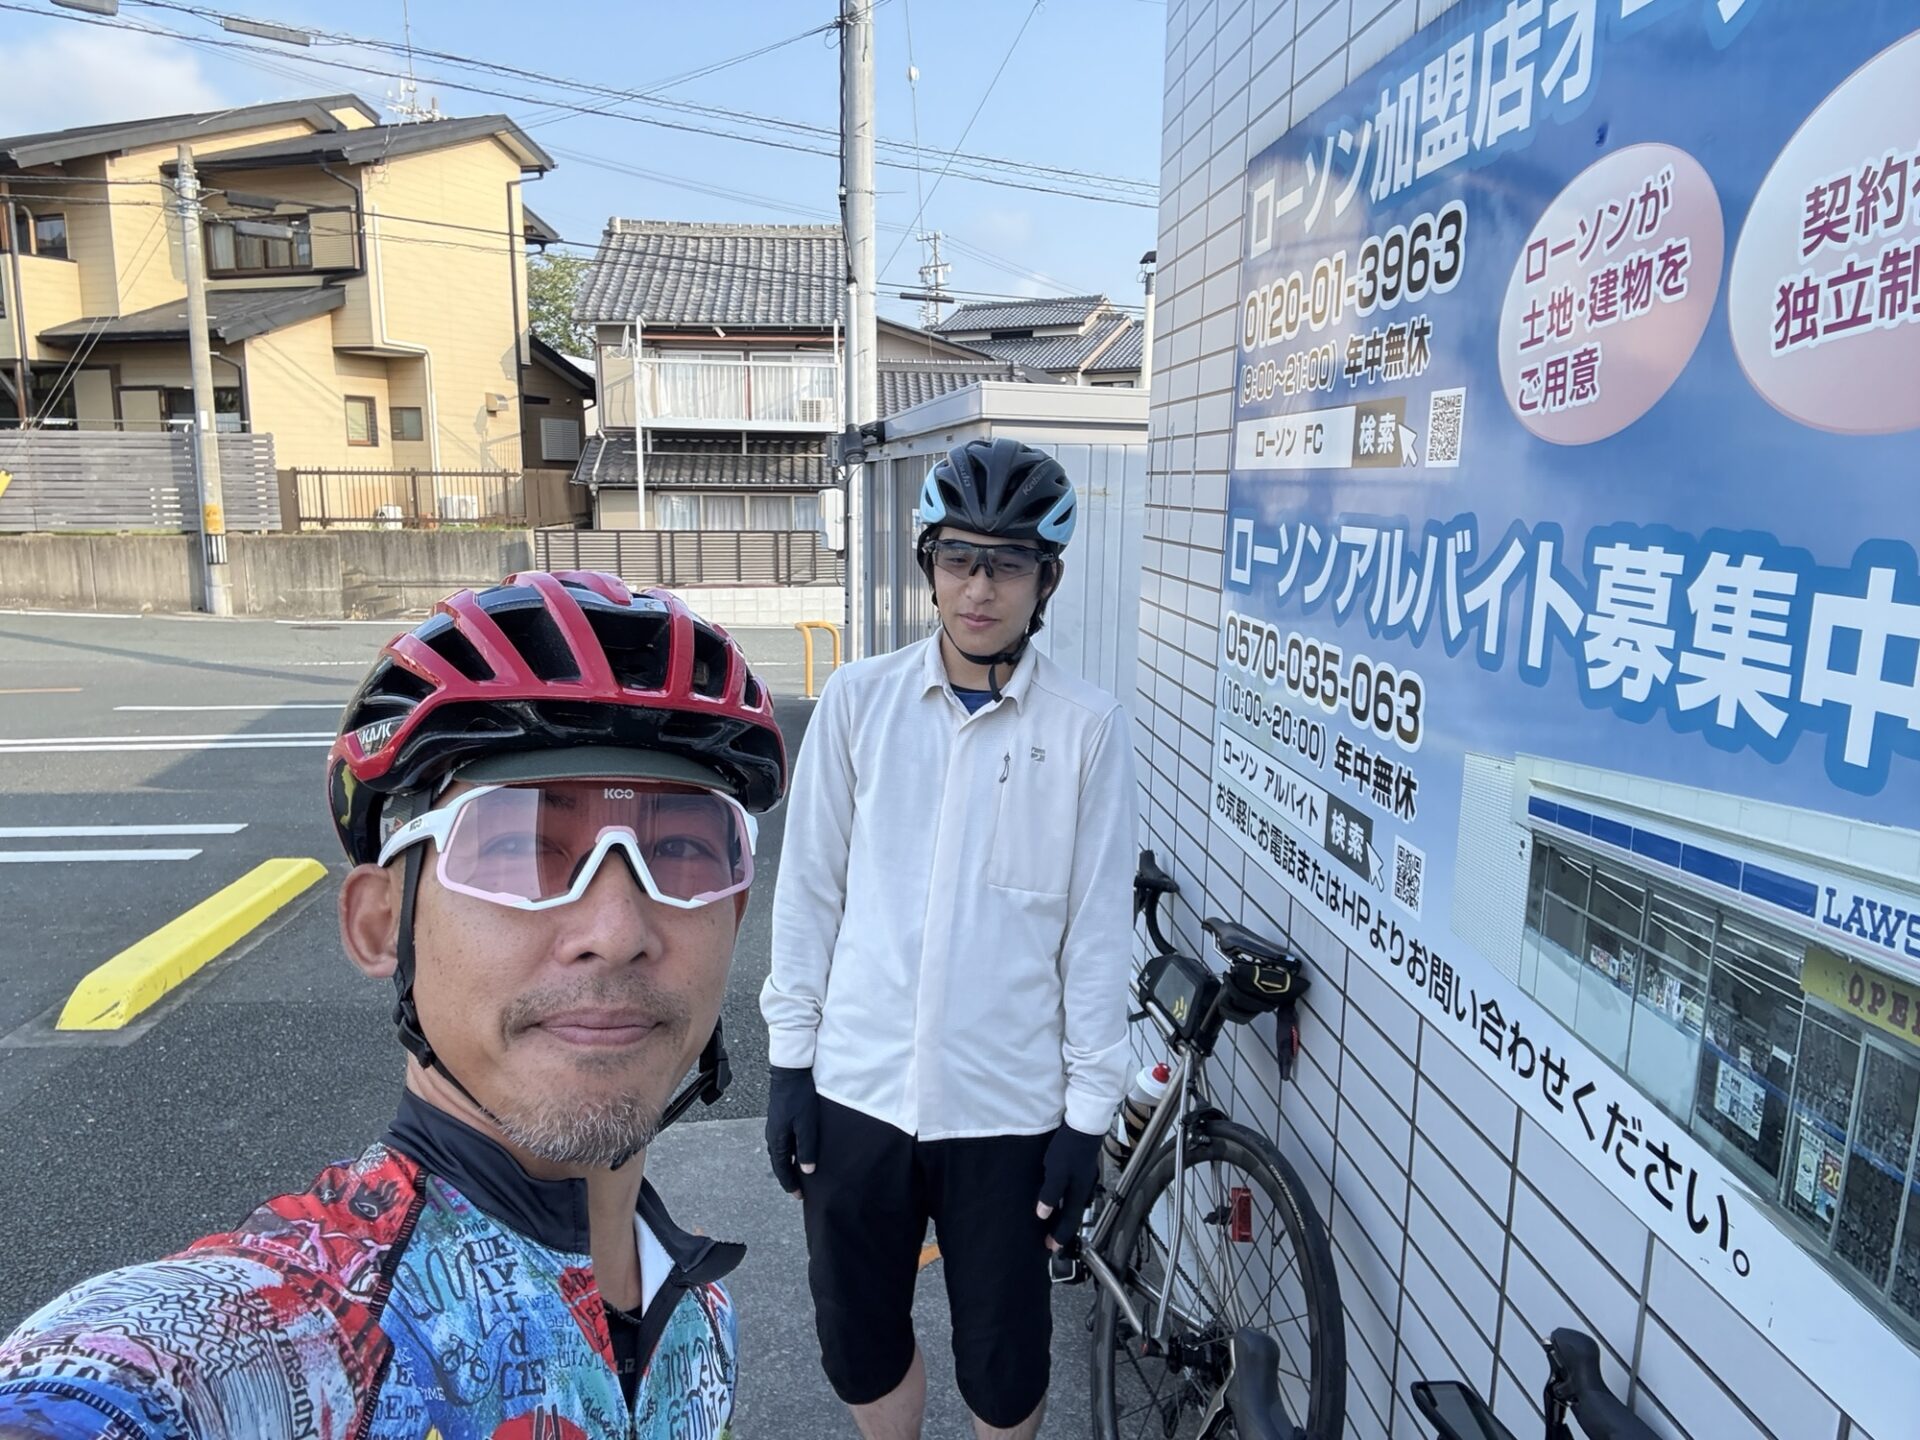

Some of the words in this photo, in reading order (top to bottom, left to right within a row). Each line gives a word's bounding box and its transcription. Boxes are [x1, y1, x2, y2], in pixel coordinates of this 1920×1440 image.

[1251, 0, 1745, 259] ローソン加盟店オ
[1525, 170, 1671, 285] ローソンが
[1803, 156, 1920, 257] 契約
[1243, 205, 1464, 350] 0120-01-3963
[1519, 243, 1688, 350] 土地・建物を
[1344, 316, 1432, 386] 年中無休
[1518, 347, 1600, 411] ご用意
[1255, 427, 1297, 458] ローソン
[1303, 422, 1324, 455] FC
[1359, 412, 1397, 456] 検索
[1225, 614, 1422, 746] 0570-035-063
[1229, 517, 1920, 769] ローソンアルバイト募集中
[1223, 738, 1259, 781] ローソン
[1264, 765, 1319, 827] アルバイト
[1334, 735, 1418, 822] 年中無休
[1331, 807, 1365, 864] 検索
[1216, 781, 1750, 1278] お気軽にお電話またはHPよりお問い合わせください。
